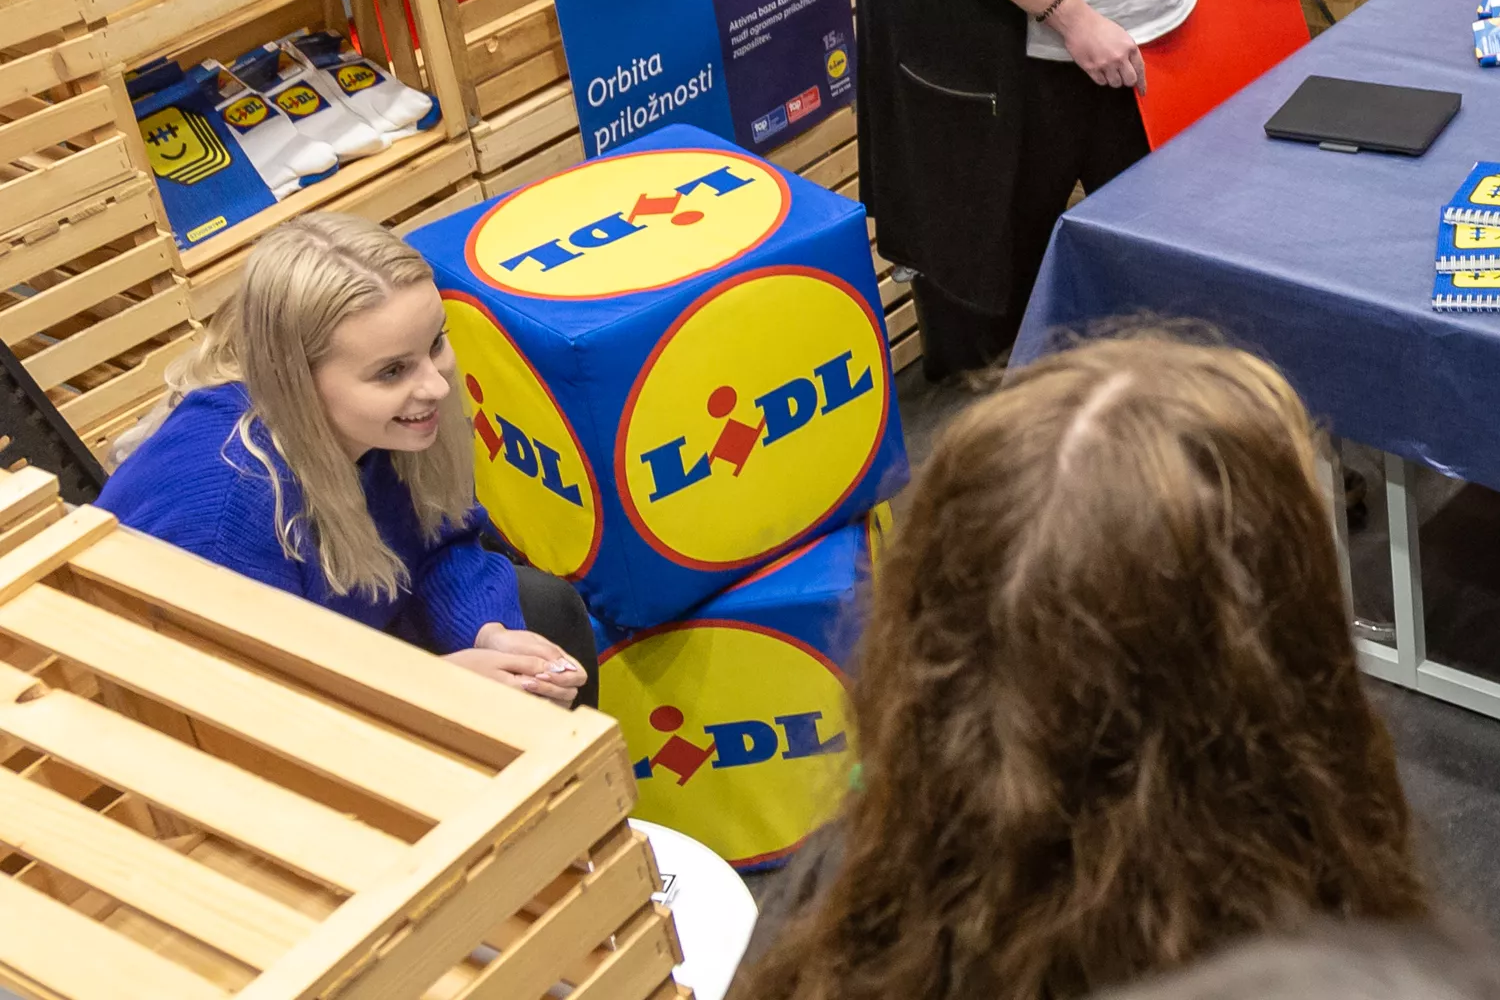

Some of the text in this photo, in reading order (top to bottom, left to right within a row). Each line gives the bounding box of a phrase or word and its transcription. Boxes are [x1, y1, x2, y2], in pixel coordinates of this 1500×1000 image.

[729, 11, 758, 33] Aktivna
[757, 1, 777, 18] baza
[731, 29, 750, 45] nudi
[749, 11, 783, 36] ogromno
[822, 30, 837, 50] 15
[587, 53, 663, 107] Orbita
[594, 63, 712, 157] priložnosti
